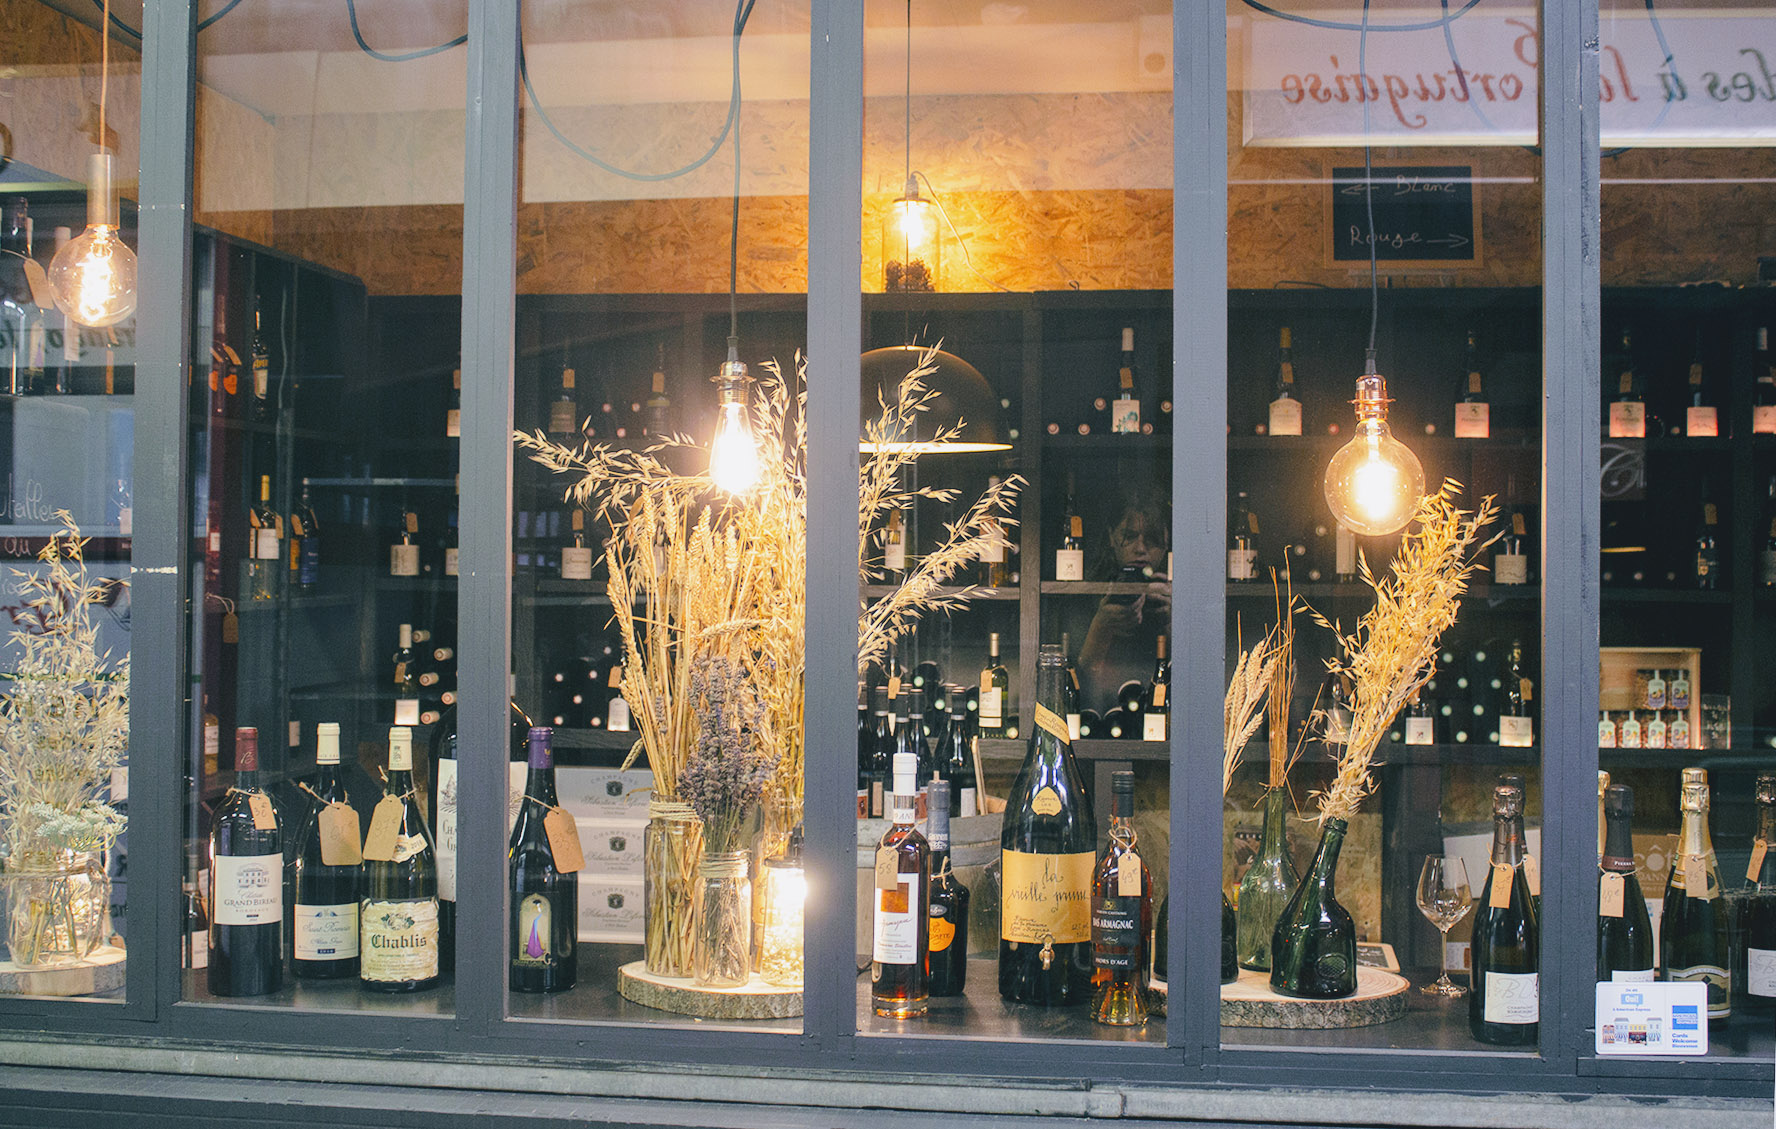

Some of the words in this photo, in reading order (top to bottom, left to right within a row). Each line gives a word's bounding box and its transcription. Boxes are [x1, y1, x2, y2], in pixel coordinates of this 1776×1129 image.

[1350, 225, 1422, 248] Rouge
[1042, 857, 1064, 889] la
[224, 898, 253, 908] GRAND
[1100, 918, 1134, 930] ARMAGNAC
[371, 933, 428, 949] Chablis
